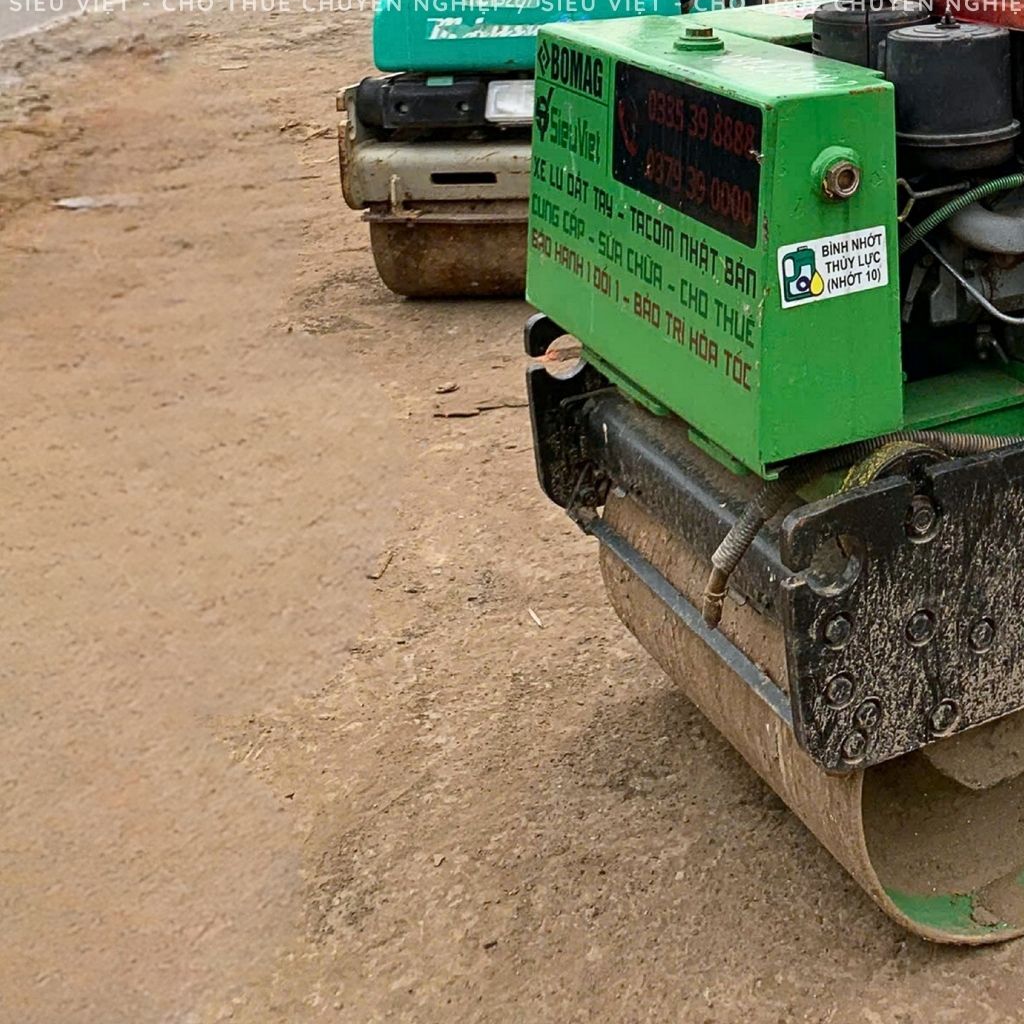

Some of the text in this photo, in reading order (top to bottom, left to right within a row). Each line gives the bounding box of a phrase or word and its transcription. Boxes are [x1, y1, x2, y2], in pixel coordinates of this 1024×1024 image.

[551, 43, 603, 99] BOMAG
[533, 156, 547, 182] XE
[593, 186, 613, 219] TAY
[630, 205, 675, 253] TACOM
[822, 233, 882, 257] BÌNH NHỚT
[825, 251, 881, 273] THỦY LỰC
[827, 269, 881, 293] (NHỚT 10)
